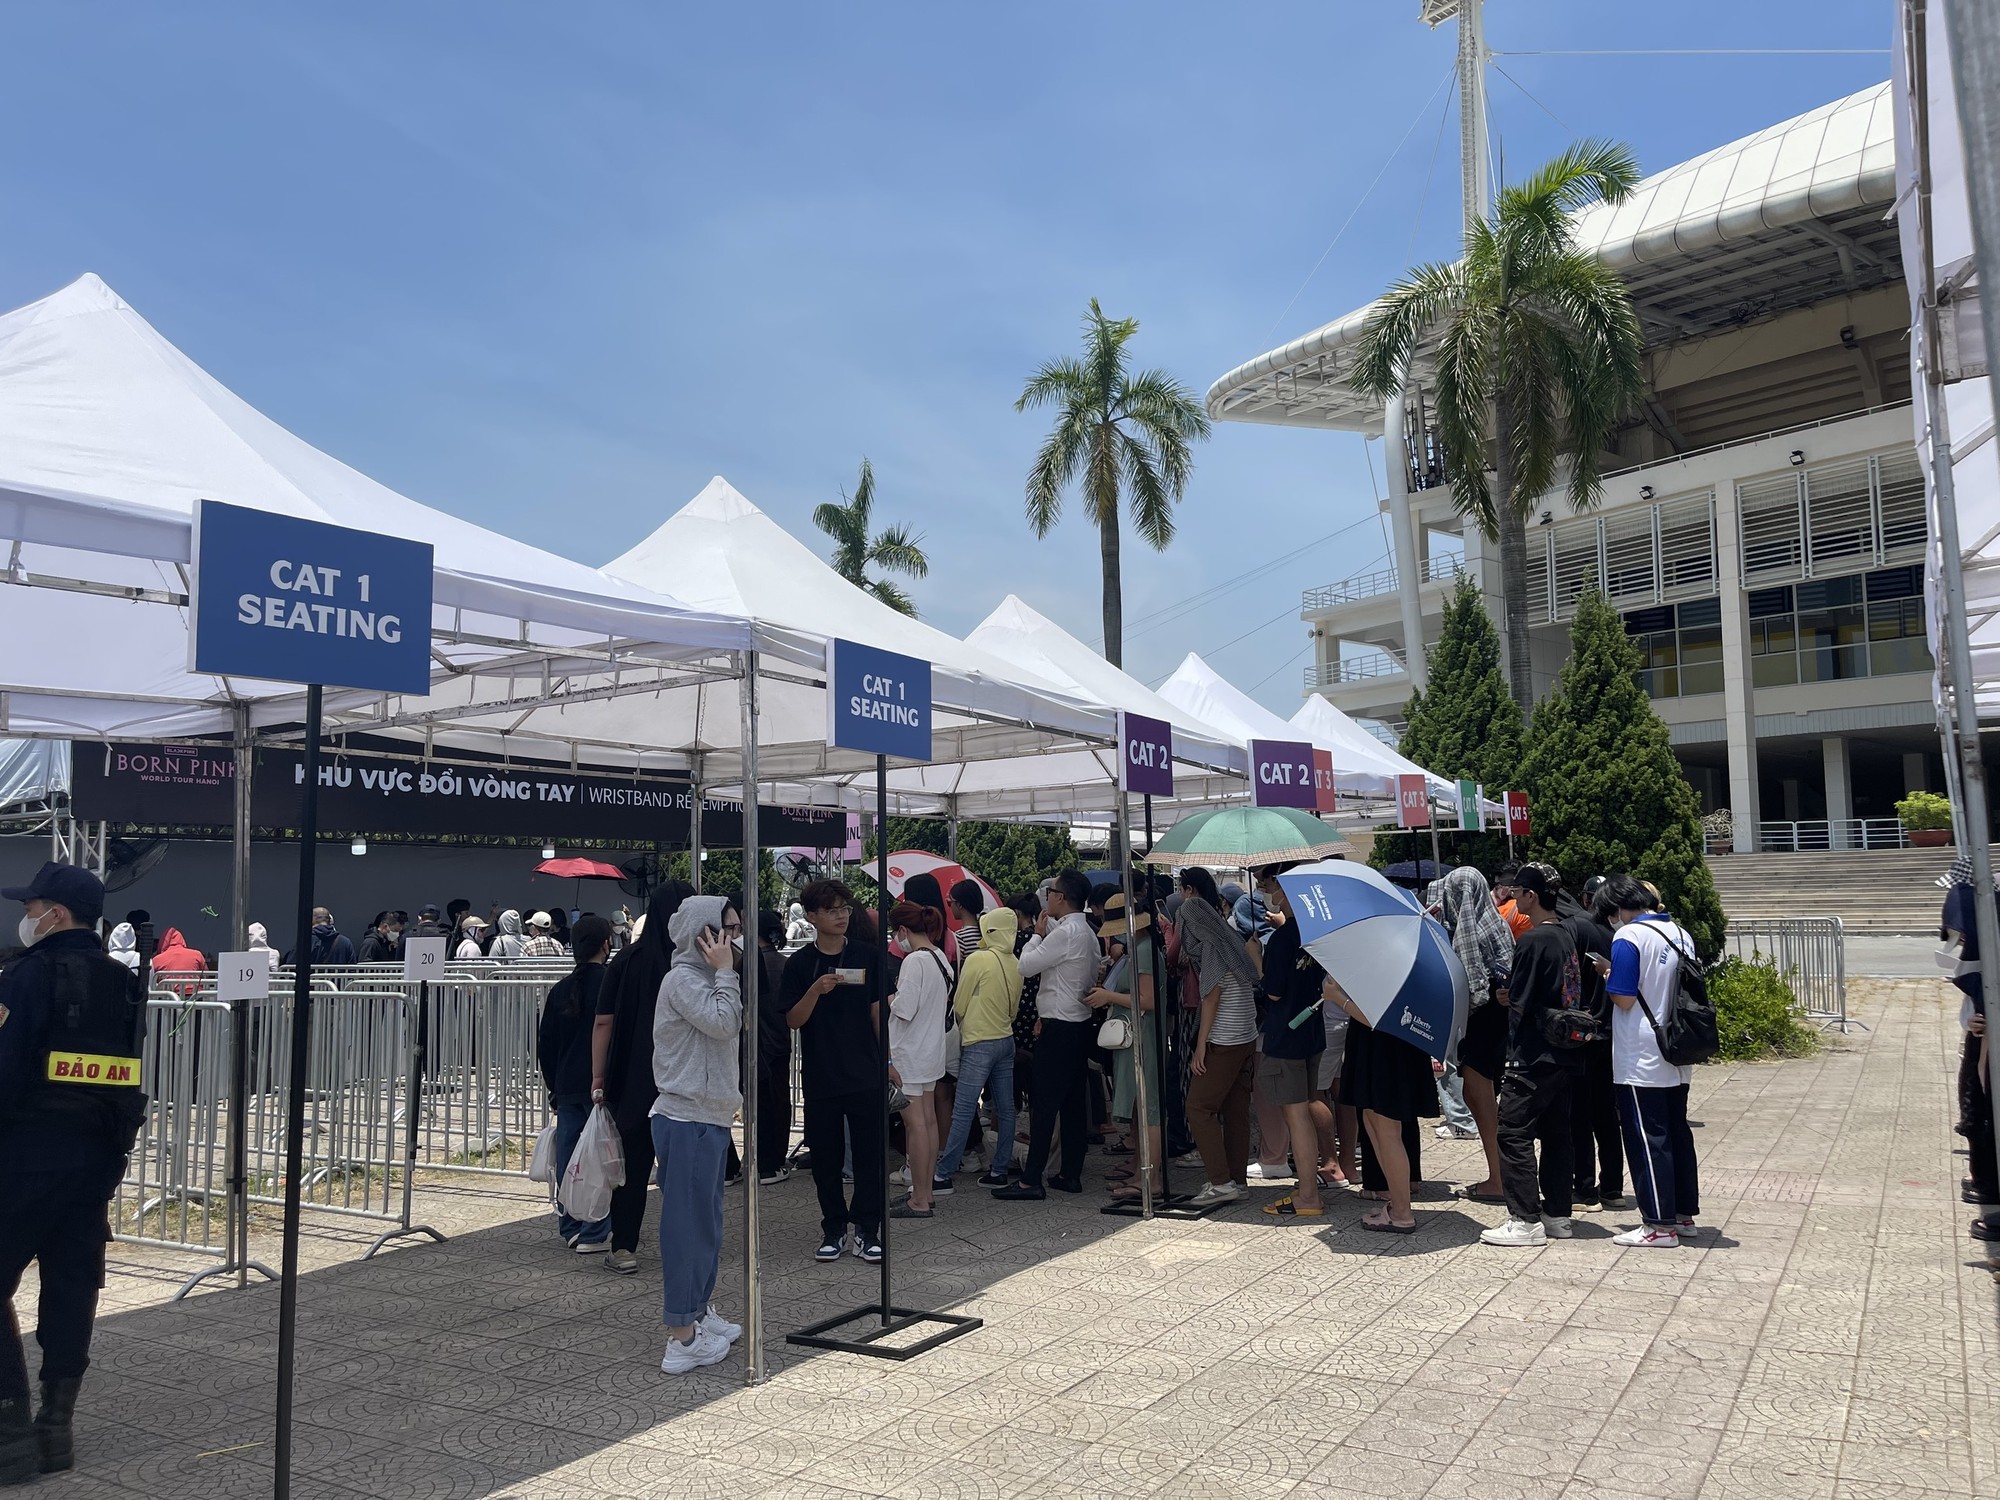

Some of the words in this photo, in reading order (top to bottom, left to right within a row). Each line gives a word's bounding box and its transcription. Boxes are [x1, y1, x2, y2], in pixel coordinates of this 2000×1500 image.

[270, 559, 342, 597] CAT
[357, 574, 370, 602] 1
[238, 593, 401, 644] SEATING
[863, 674, 893, 697] CAT
[899, 682, 905, 701] 1
[850, 696, 919, 727] SEATING
[117, 753, 181, 774] BORN
[1129, 739, 1156, 767] CAT
[1160, 745, 1168, 770] 2
[141, 774, 170, 783] WORLD
[173, 776, 194, 784] TOUR
[1259, 762, 1293, 785] CAT
[1298, 764, 1310, 785] 2
[1325, 770, 1332, 790] 3
[359, 767, 413, 796] VỰC
[418, 768, 462, 796] ĐỔI
[468, 773, 531, 801] VÒNG
[536, 782, 575, 803] TAY
[588, 786, 672, 808] WRISTBAND
[1402, 790, 1418, 808] CAT
[1420, 791, 1426, 808] 3
[1510, 806, 1522, 820] CAT
[1523, 807, 1528, 821] 5
[421, 952, 435, 965] 20
[238, 968, 254, 982] 19
[55, 1056, 100, 1079] BẢO
[106, 1065, 131, 1081] AN
